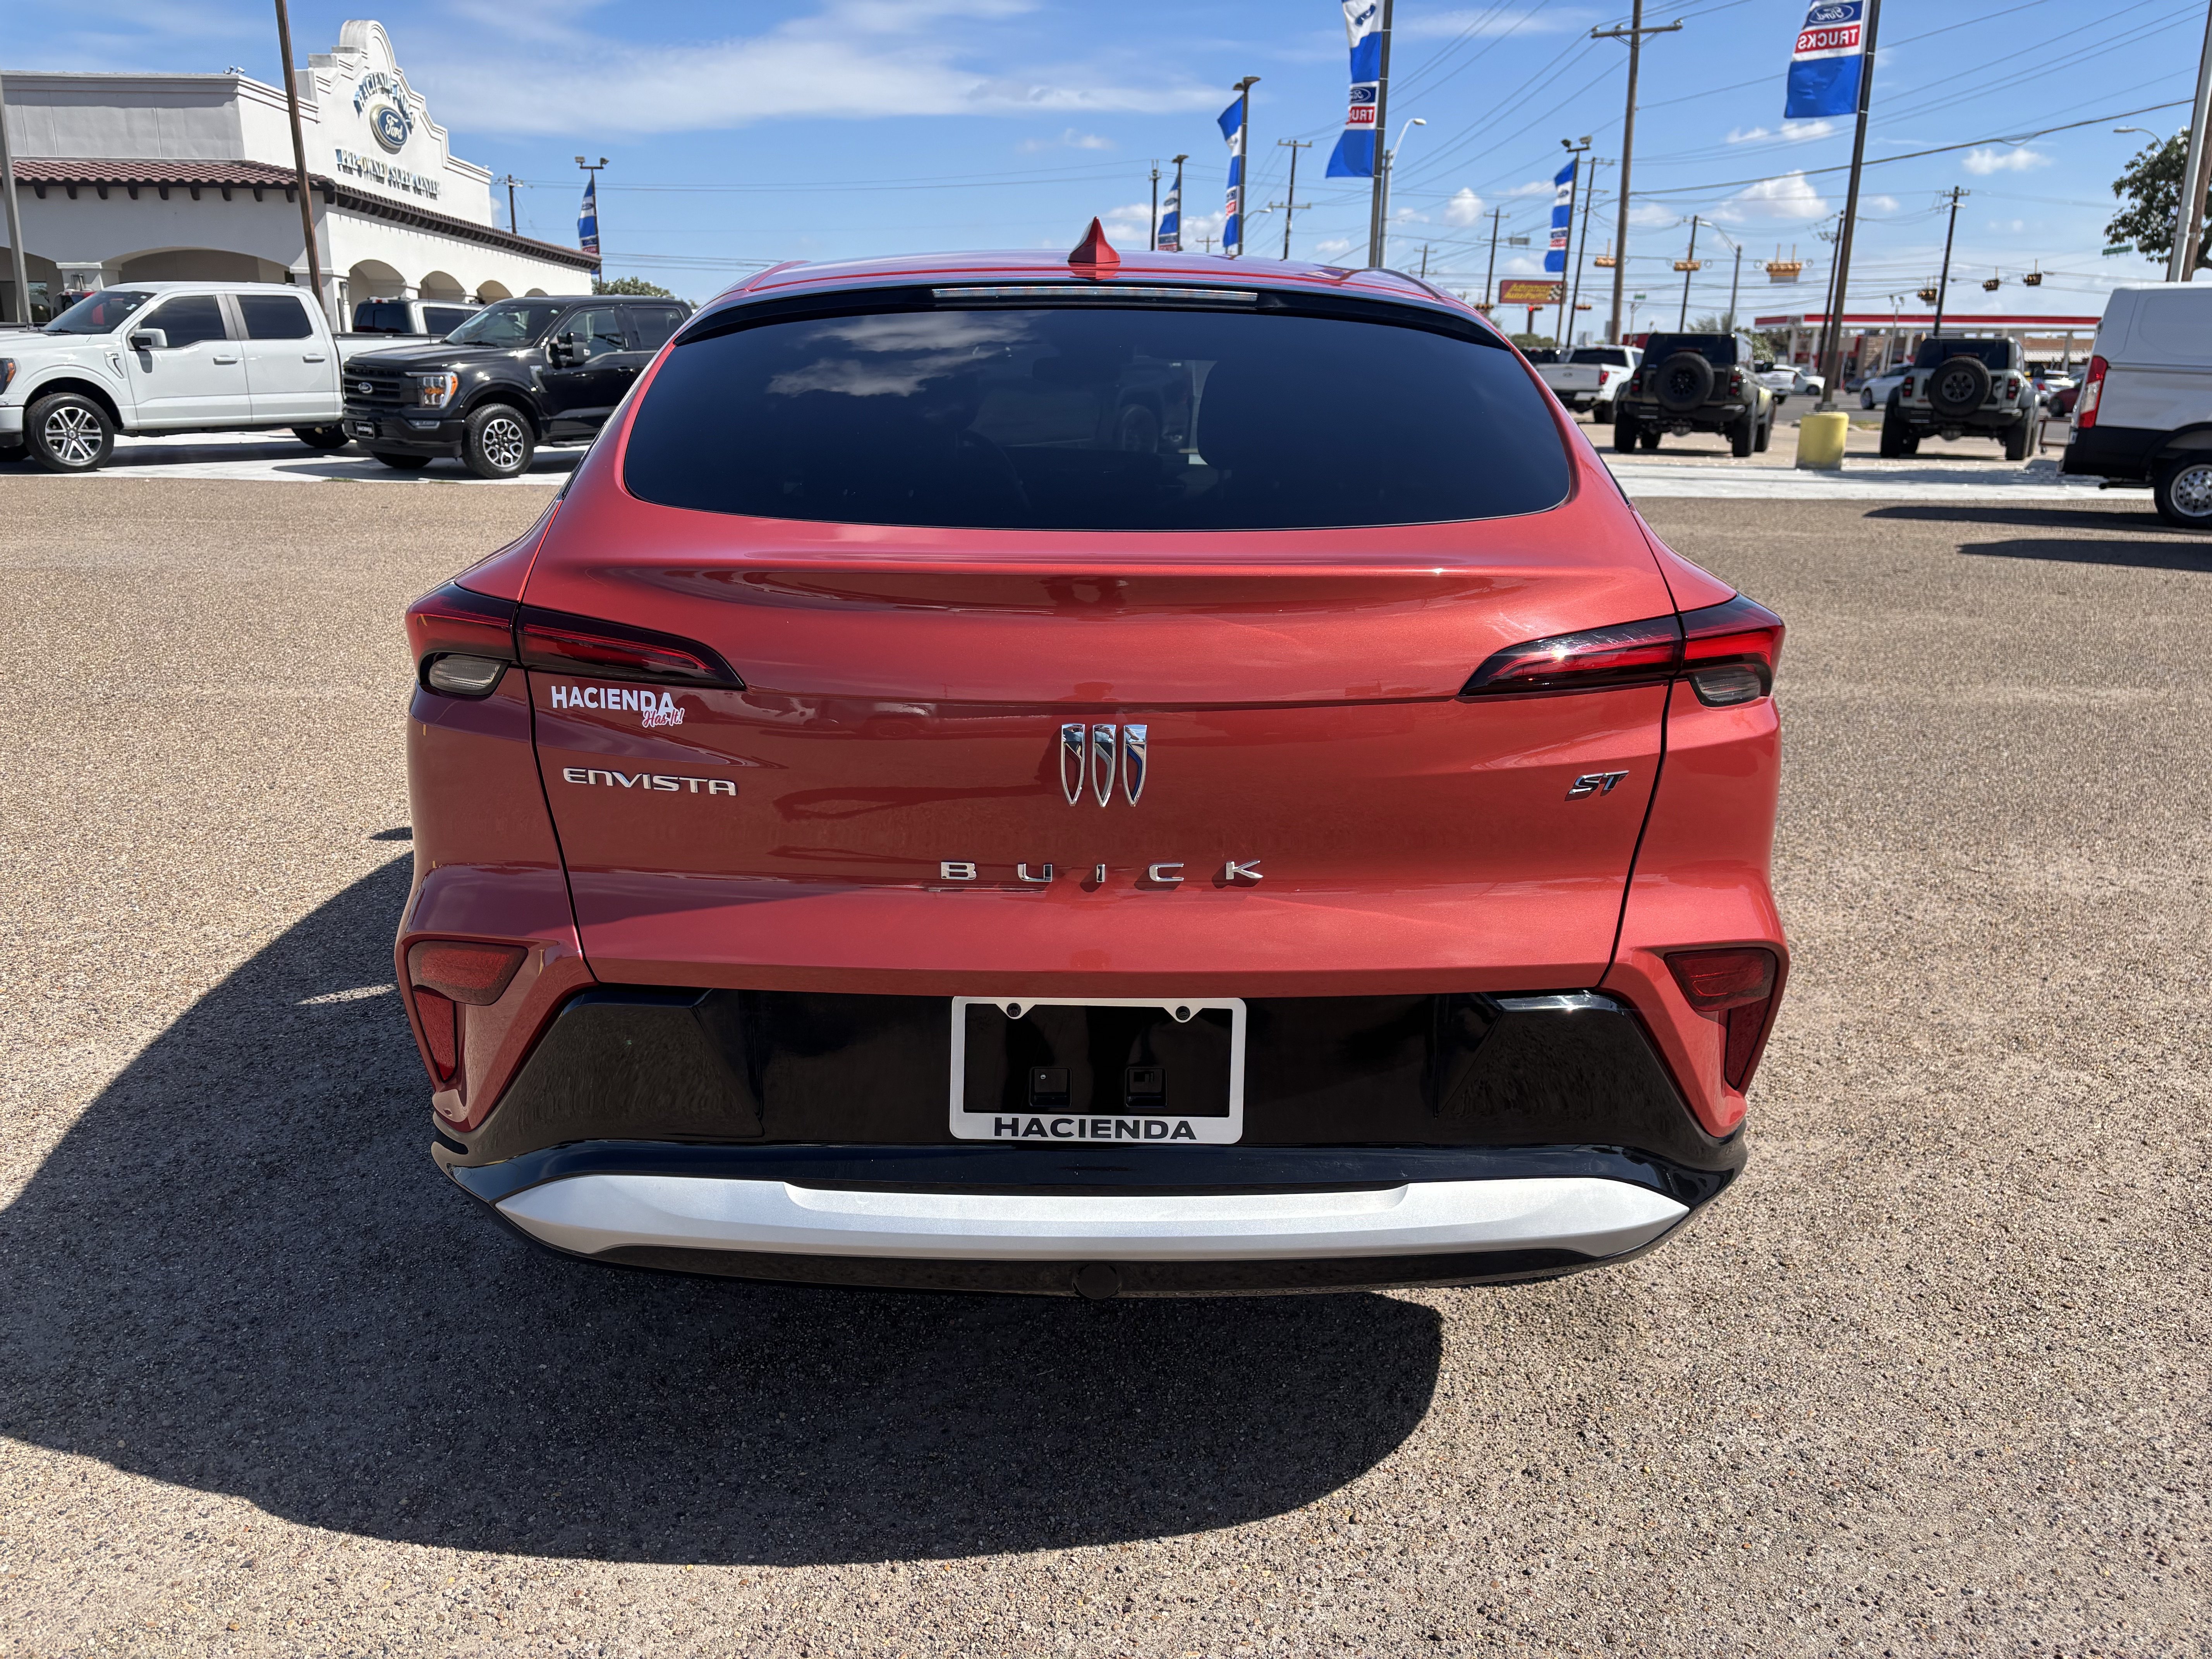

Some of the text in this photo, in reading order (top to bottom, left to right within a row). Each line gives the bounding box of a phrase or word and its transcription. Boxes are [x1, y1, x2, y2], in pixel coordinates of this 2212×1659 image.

[385, 114, 404, 140] Ford
[551, 686, 676, 714] HACIENDA
[642, 708, 685, 728] Has It!
[563, 768, 737, 796] ENVISTA
[1569, 770, 1630, 794] ST
[941, 859, 1264, 883] BUICK
[994, 1117, 1197, 1140] HACIENDA
